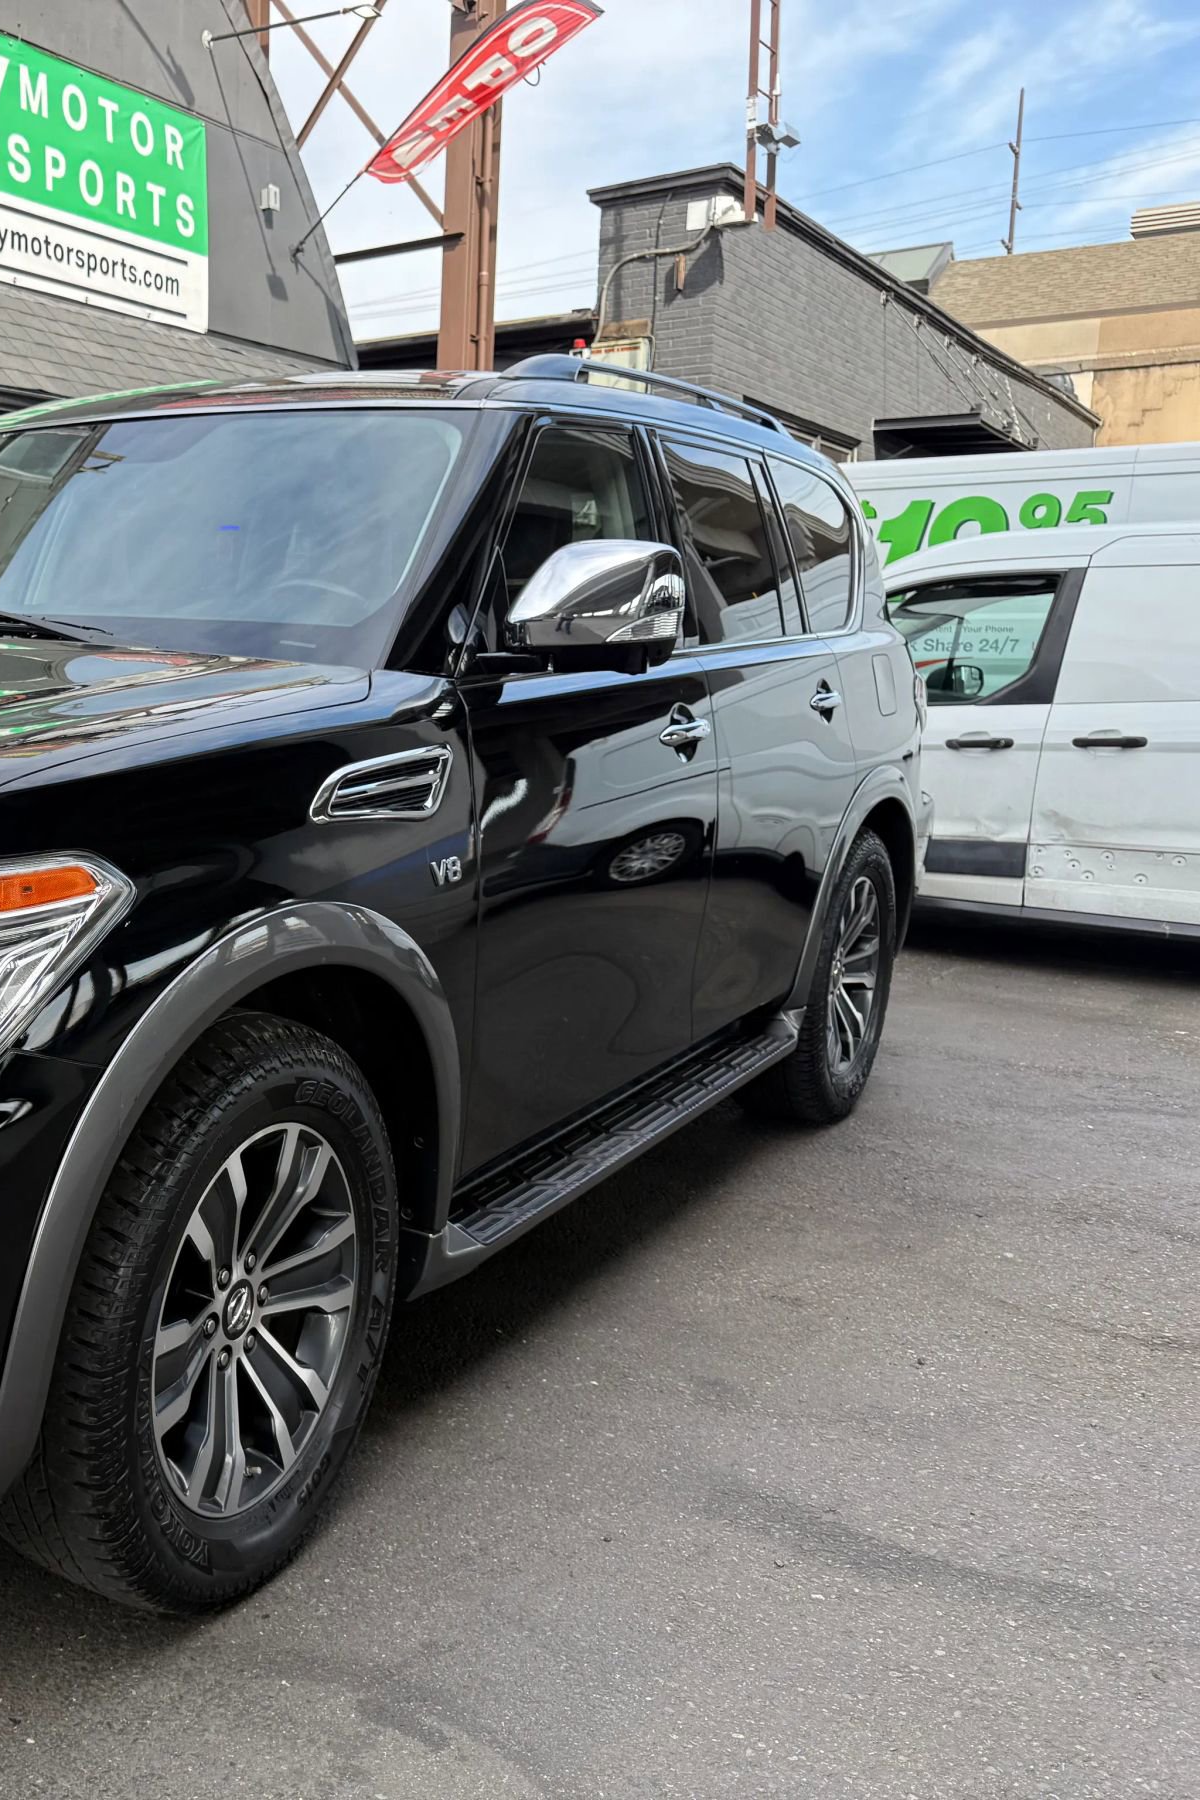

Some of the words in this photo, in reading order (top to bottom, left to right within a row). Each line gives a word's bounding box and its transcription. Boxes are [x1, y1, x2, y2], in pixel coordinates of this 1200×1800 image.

[18, 63, 185, 171] MOTOR
[7, 133, 196, 238] SPORTS
[985, 624, 1015, 633] Phone
[978, 635, 1020, 655] 24/7
[429, 856, 462, 887] V8
